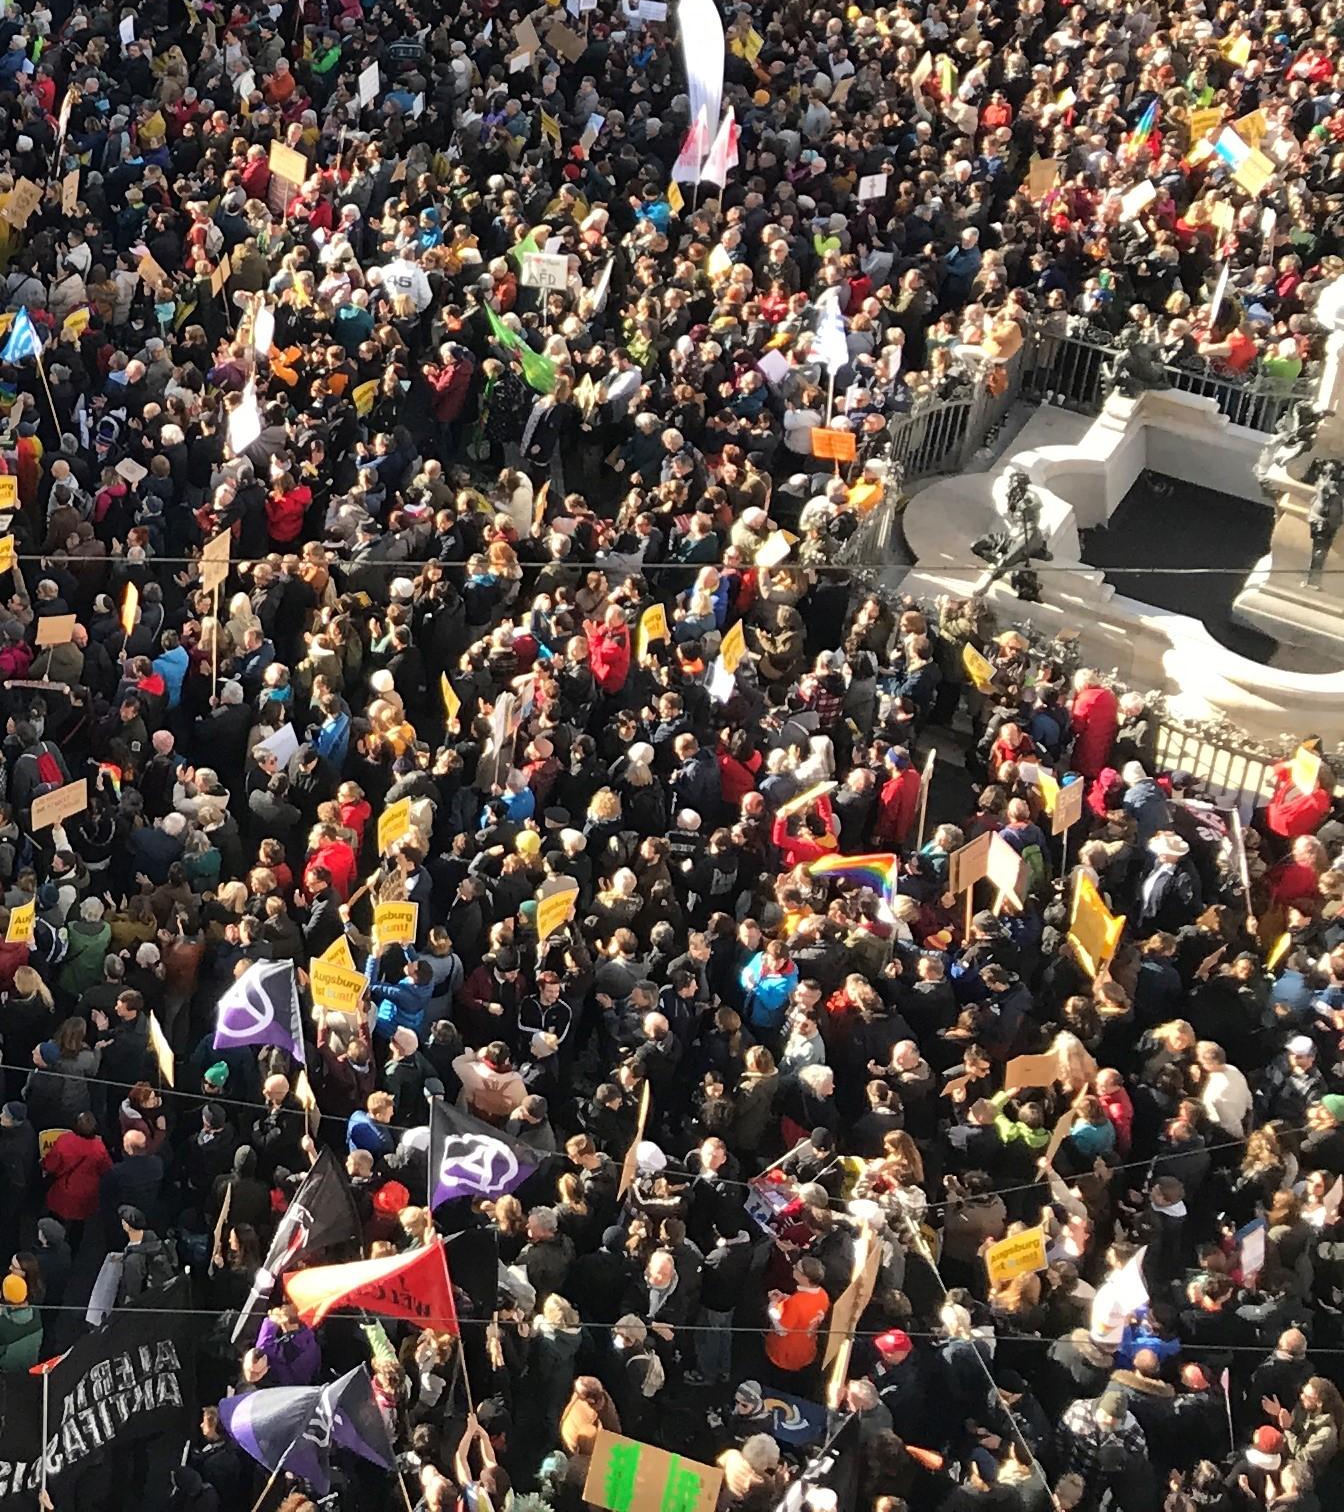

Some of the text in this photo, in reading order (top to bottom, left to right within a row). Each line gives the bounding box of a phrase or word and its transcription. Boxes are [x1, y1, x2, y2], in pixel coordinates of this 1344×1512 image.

[386, 274, 413, 289] 45
[15, 926, 29, 935] ist
[313, 970, 362, 992] Augsburg
[315, 986, 325, 996] ist
